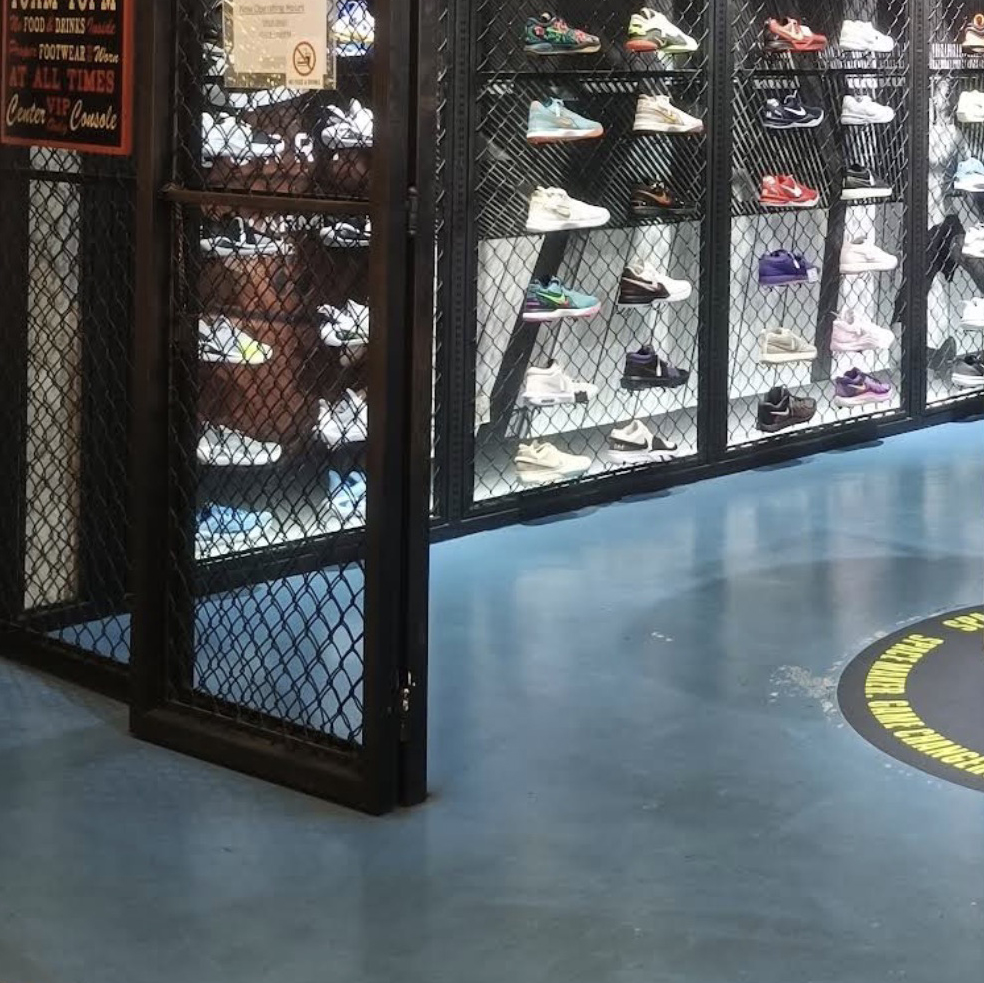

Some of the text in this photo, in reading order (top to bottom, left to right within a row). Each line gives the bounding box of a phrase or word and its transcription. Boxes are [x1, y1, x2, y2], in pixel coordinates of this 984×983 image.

[23, 16, 46, 33] FOOD
[55, 17, 86, 35] DRINKS
[39, 43, 86, 61] FOOTWEAR
[93, 44, 119, 63] Worn
[9, 65, 115, 94] AT ALL TIMES
[5, 93, 118, 132] Center VIP Console
[880, 634, 944, 663] SPACE
[865, 661, 913, 698] MAKER.
[868, 700, 925, 729] GAME
